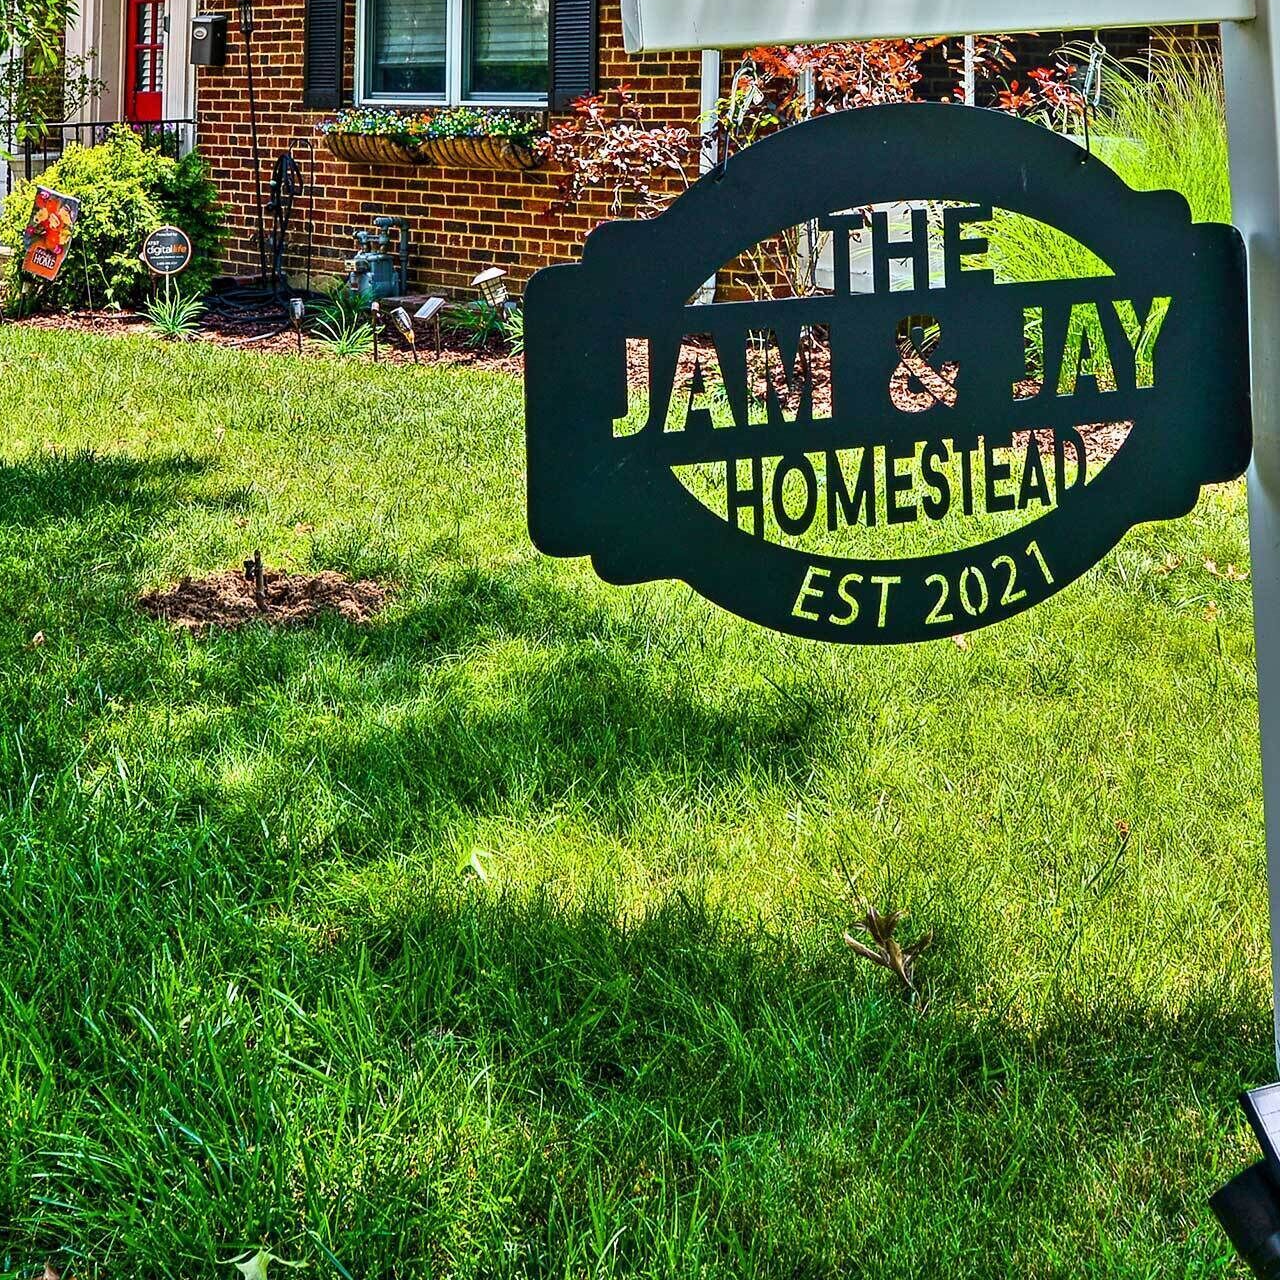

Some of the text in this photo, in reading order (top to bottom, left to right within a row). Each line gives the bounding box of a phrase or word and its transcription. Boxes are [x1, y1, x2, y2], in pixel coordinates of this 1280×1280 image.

[32, 253, 56, 270] HOME
[818, 206, 993, 294] THE
[613, 296, 1172, 438] JAM & JAY
[726, 424, 1087, 538] HOMESTEAD
[791, 540, 1055, 628] EST 2021
